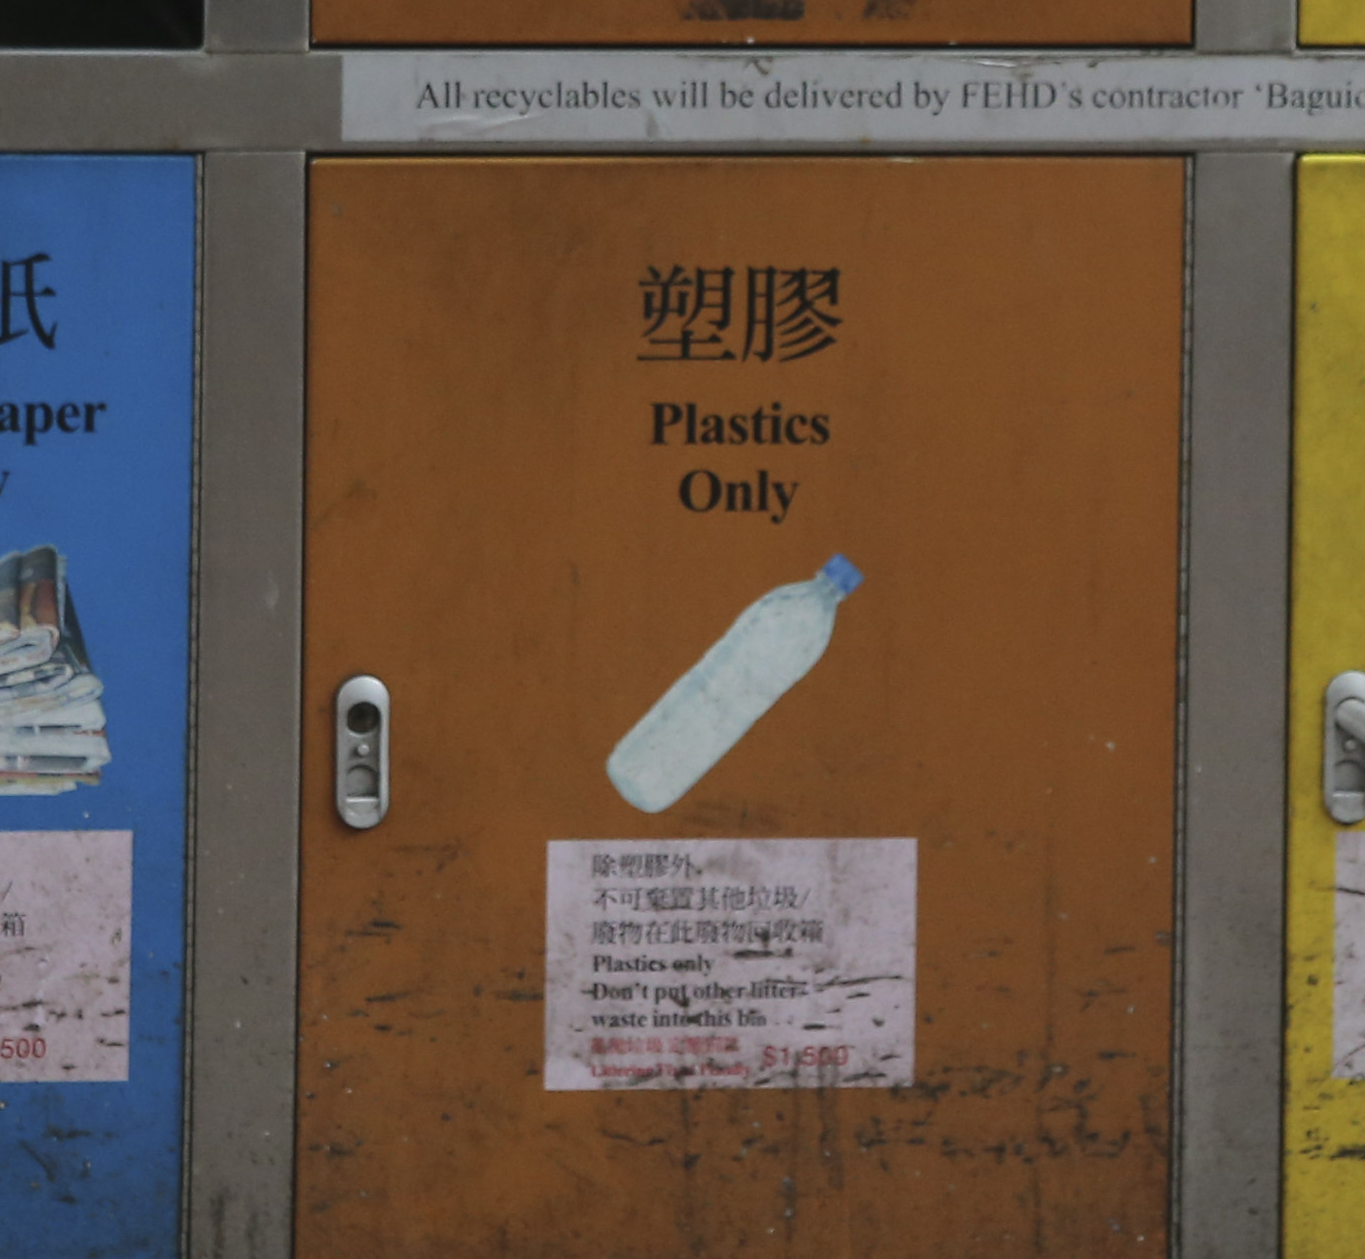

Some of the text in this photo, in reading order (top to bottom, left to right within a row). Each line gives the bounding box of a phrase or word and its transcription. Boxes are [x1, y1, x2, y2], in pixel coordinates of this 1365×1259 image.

[416, 82, 462, 110] All
[473, 82, 642, 117] recyclables
[651, 82, 709, 110] will
[719, 82, 755, 110] be
[763, 82, 903, 110] delivered
[913, 82, 950, 117] by
[961, 82, 1083, 110] FEHD's
[1092, 82, 1241, 110] contractor
[636, 263, 844, 364] 塑膠
[649, 401, 831, 447] Plastics
[678, 468, 800, 525] Only
[592, 954, 715, 976] Plastics only
[592, 983, 649, 1000] Don't
[654, 983, 688, 1004] put
[693, 983, 744, 1000] other
[591, 1012, 768, 1028] waste into this bin
